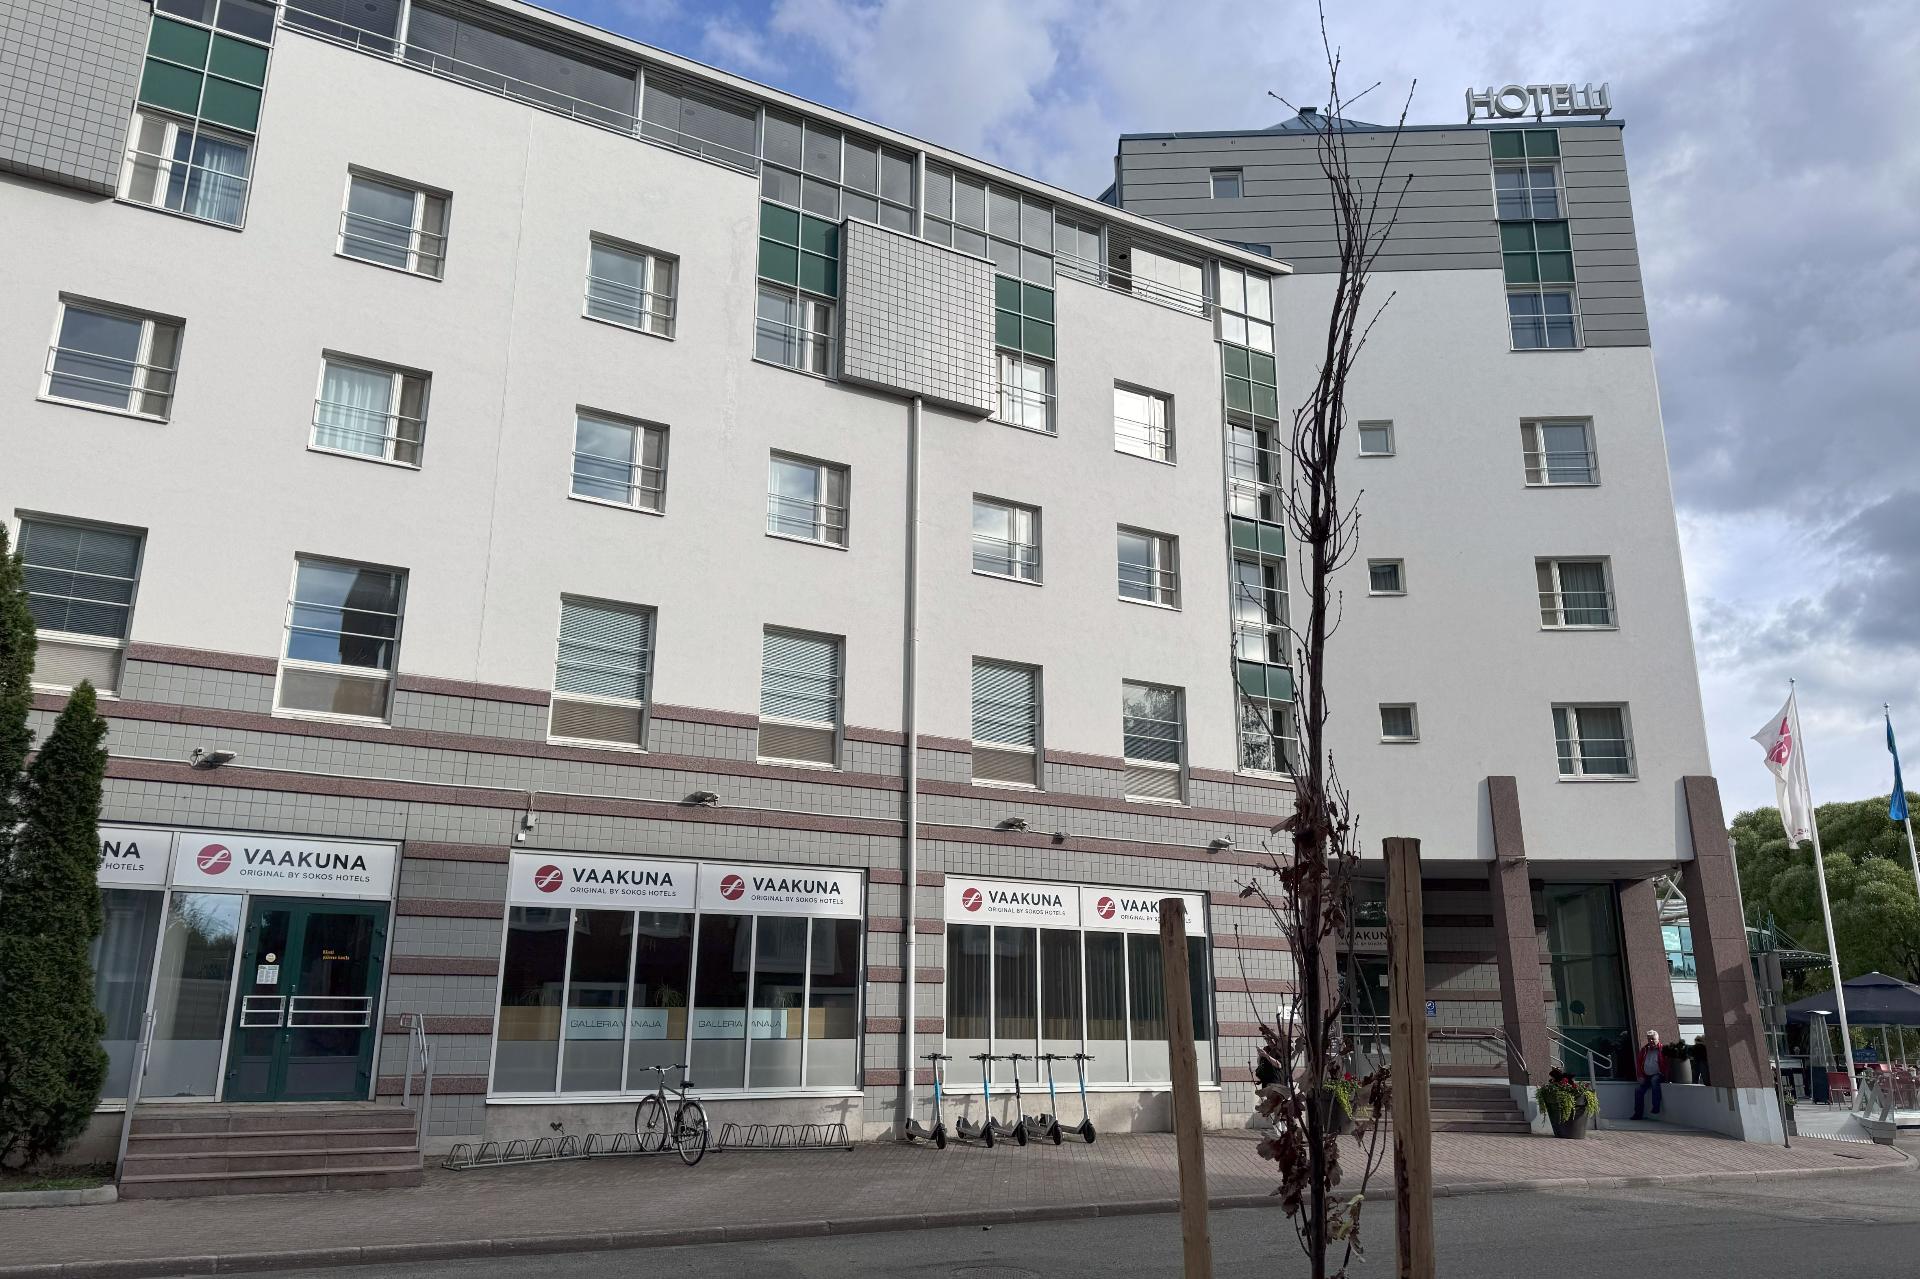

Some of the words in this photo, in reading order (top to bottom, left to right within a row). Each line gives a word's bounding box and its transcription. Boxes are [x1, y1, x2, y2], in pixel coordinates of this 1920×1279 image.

[244, 848, 367, 871] VAAKUNA
[105, 863, 145, 871] HOTELS
[239, 869, 285, 878] ORIGINAL
[302, 873, 333, 881] SOKOS
[335, 875, 370, 883] HOTELS
[573, 868, 673, 887] VAAKUNA
[570, 886, 606, 895] ORIGINAL
[752, 876, 841, 895] VAAKUNA
[751, 894, 783, 902] ORIGINAL
[988, 890, 1063, 908] VAAKUNA
[570, 1020, 619, 1028] GALLERIA
[698, 1020, 743, 1028] GALLERIA
[751, 1020, 781, 1028] ANAJA
